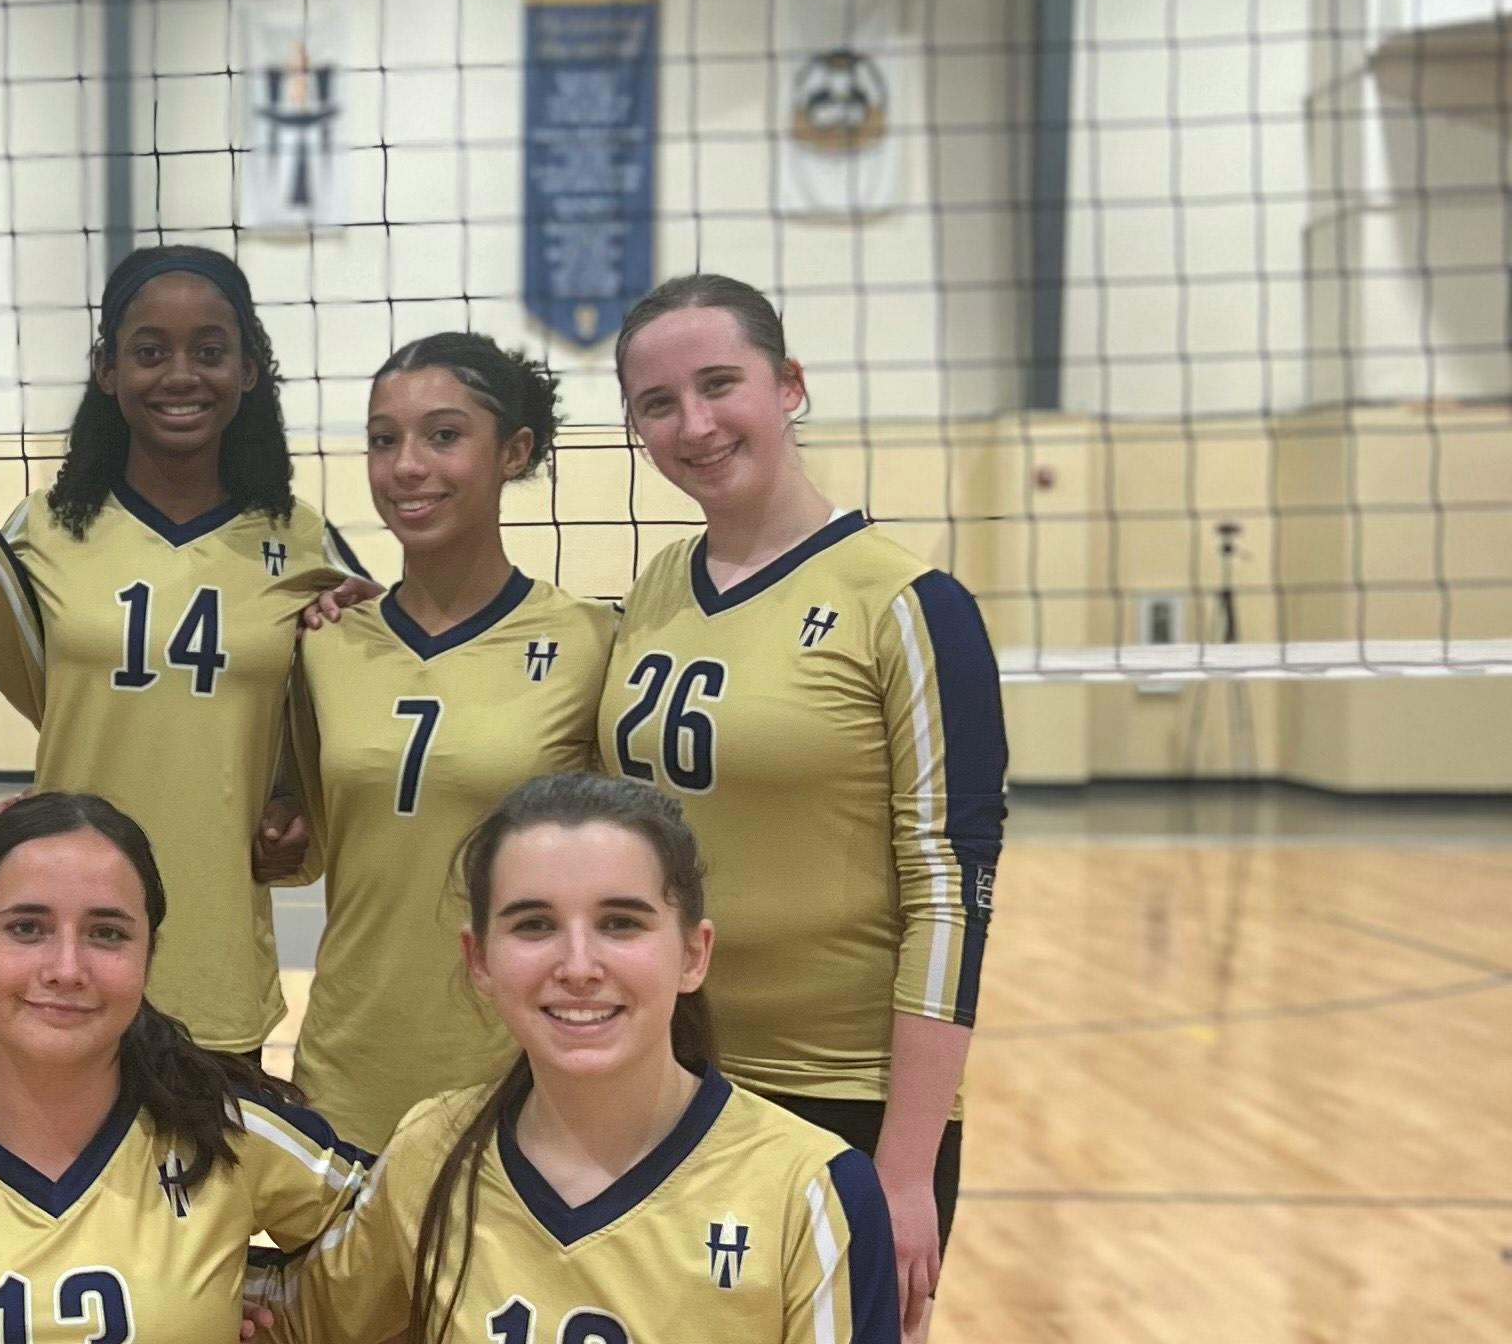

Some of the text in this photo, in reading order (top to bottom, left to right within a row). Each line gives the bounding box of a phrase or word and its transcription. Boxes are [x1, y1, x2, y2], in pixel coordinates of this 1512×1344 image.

[110, 580, 230, 697] 14
[391, 696, 444, 816] 7
[614, 649, 727, 795] 26
